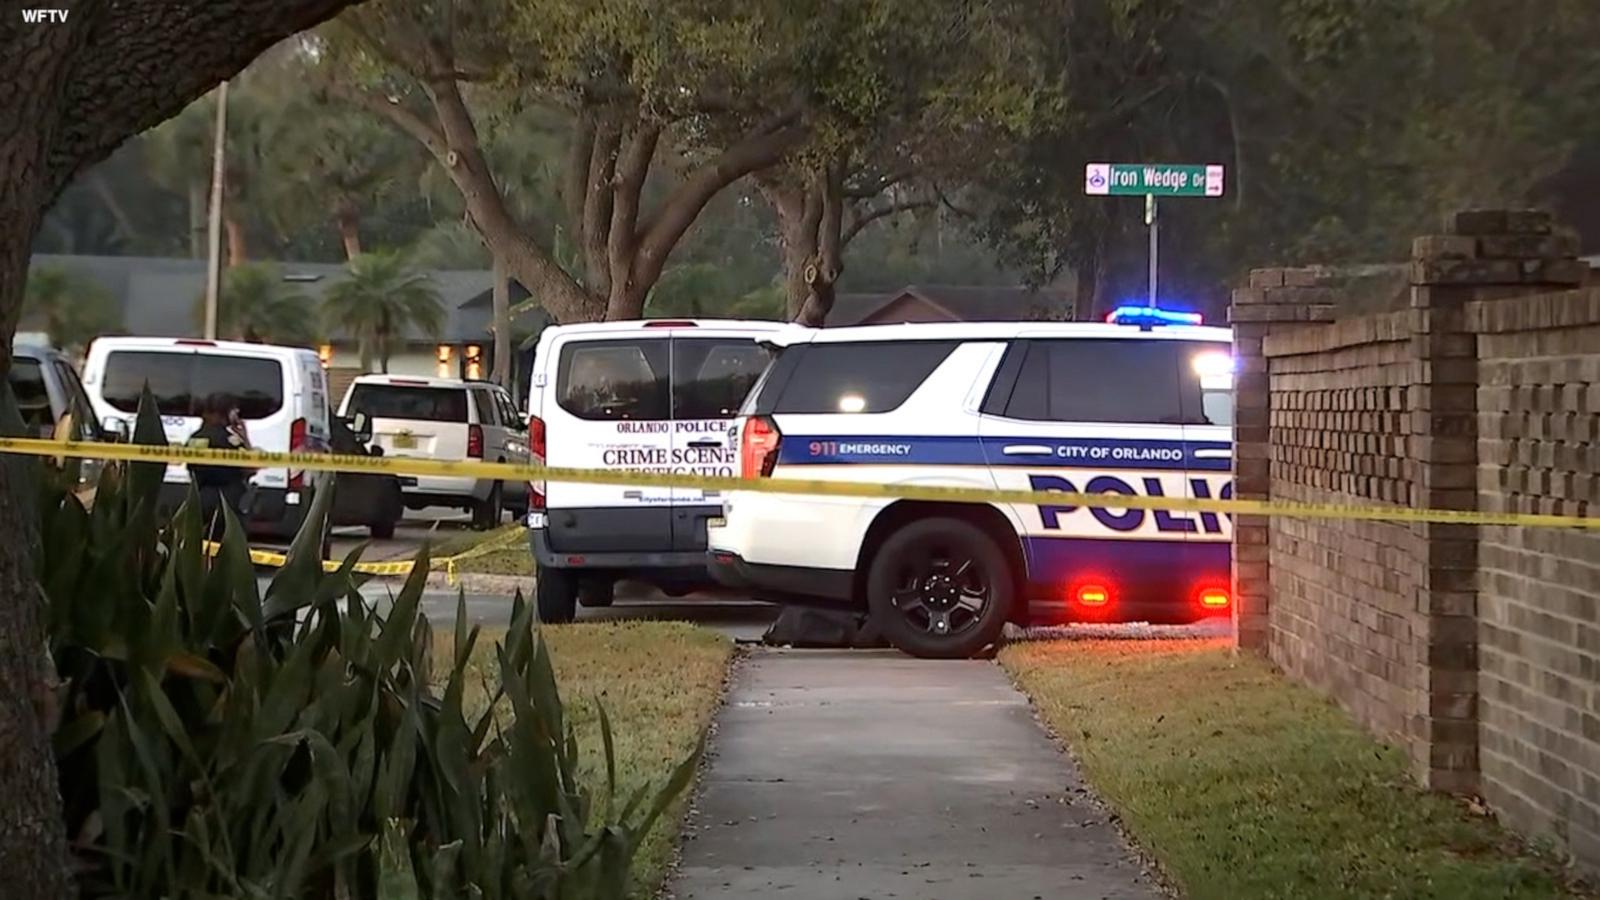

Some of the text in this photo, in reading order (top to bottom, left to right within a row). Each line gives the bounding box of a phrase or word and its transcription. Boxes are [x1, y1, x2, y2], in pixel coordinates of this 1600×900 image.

[1110, 168, 1138, 186] Iron
[1143, 167, 1188, 192] Wedge
[617, 421, 727, 433] ORLANDO POLICE
[809, 441, 911, 456] 911 EMERGENCY
[1057, 446, 1182, 460] CITY OF ORLANDO
[603, 448, 735, 465] CRIME SCENE
